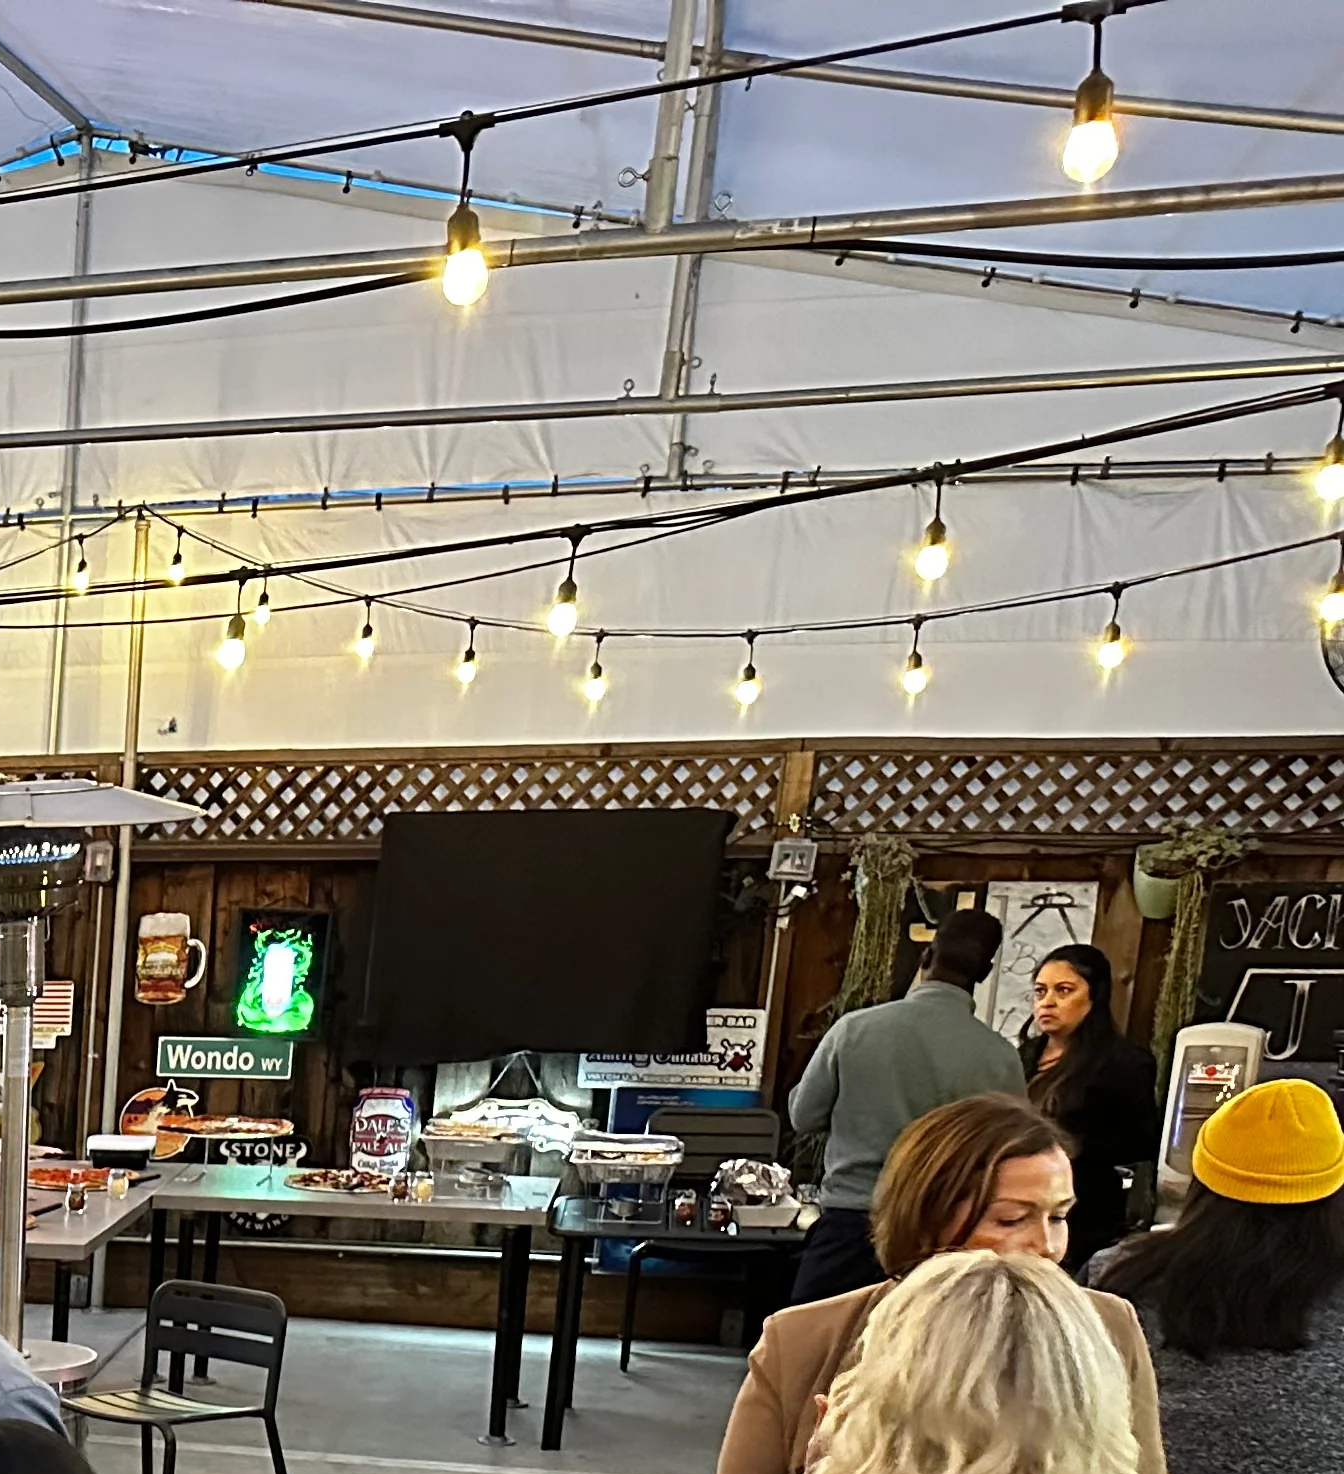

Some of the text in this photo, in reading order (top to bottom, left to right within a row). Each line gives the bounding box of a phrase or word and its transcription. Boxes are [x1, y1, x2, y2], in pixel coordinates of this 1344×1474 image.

[726, 1016, 756, 1028] BAR
[167, 1044, 284, 1071] Wondo WY
[230, 1142, 296, 1158] STONE
[352, 1141, 409, 1153] PALE ALE
